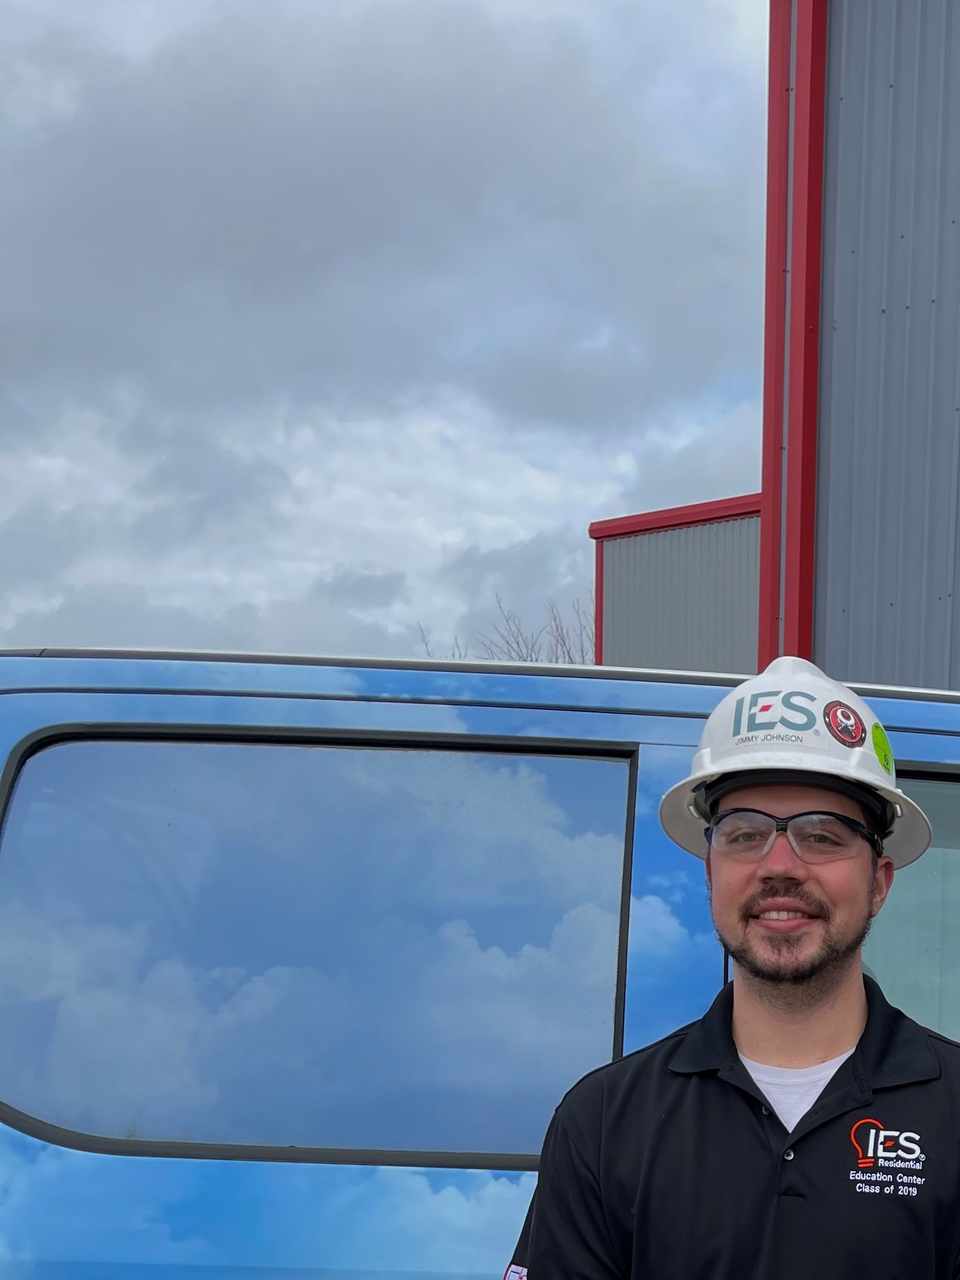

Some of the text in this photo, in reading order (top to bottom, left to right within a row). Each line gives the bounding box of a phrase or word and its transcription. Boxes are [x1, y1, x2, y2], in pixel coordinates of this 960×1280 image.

[732, 690, 818, 738] IES
[734, 733, 804, 746] JIMMY JOHNSON
[867, 1128, 921, 1160] IES
[878, 1159, 923, 1169] Residential
[849, 1170, 926, 1185] Education Center
[856, 1182, 918, 1196] Class of 2019
